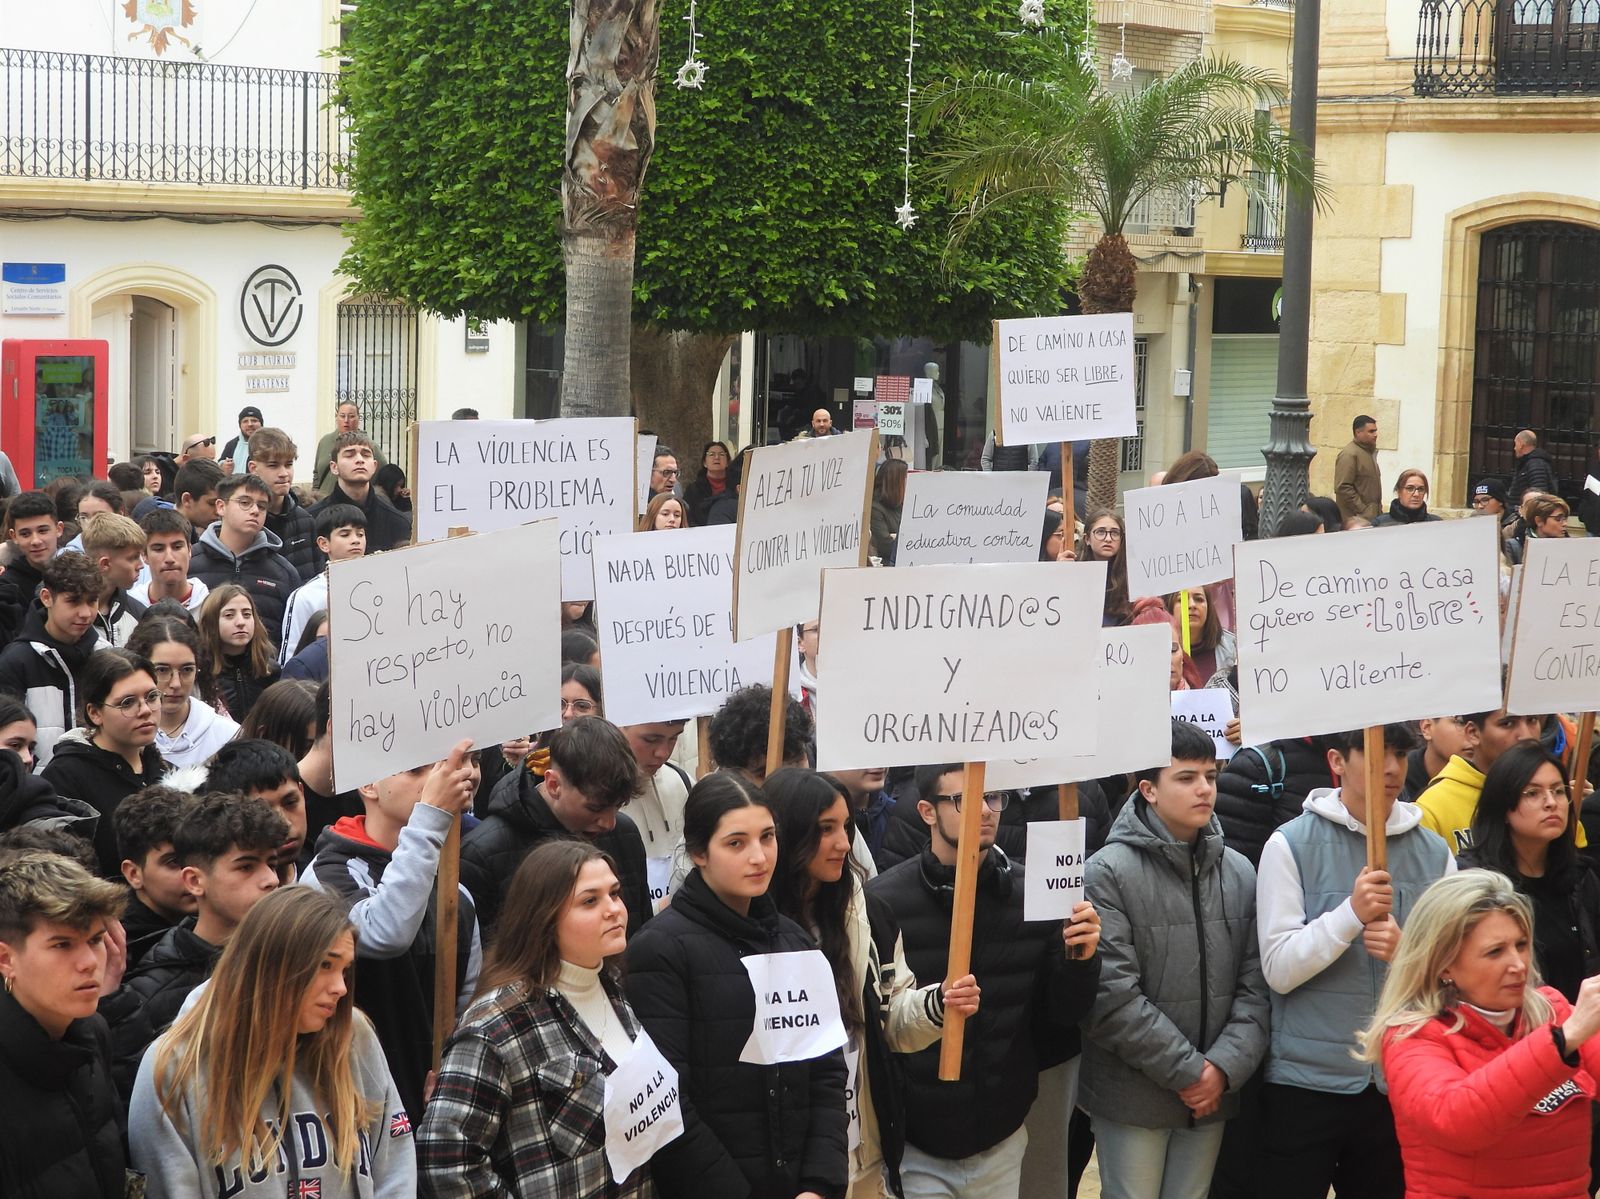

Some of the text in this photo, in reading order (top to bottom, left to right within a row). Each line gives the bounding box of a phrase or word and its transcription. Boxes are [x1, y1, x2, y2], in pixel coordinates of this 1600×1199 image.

[1008, 328, 1127, 352] DE CAMINO A CASA
[238, 354, 296, 366] CLUB TAURINO
[1008, 364, 1124, 384] QUIERO SER LIBRE,
[247, 378, 289, 389] VERATENSE
[880, 405, 902, 415] -30%
[1010, 400, 1103, 423] NO VALIENTE
[435, 434, 611, 466] LA VIOLENCIA ES
[434, 484, 467, 512] EL
[489, 477, 614, 510] PROBLEMA,
[753, 457, 844, 510] ALZA TU VOZ
[911, 494, 1027, 519] La comunidad
[1138, 493, 1220, 530] NO A LA
[747, 534, 790, 573] CONTRA
[795, 530, 808, 561] LA
[813, 513, 860, 556] VIOLENCIA
[905, 528, 1034, 550] educativa contra
[608, 558, 656, 583] NADA
[665, 553, 720, 580] BUENO
[1141, 541, 1222, 578] VIOLENCIA
[1541, 556, 1600, 587] LA E
[1258, 559, 1297, 603] De
[1305, 568, 1389, 595] camino
[1399, 571, 1414, 589] a
[343, 566, 466, 641] Si hay
[862, 594, 1062, 631] INDIGNAD@S
[1559, 602, 1588, 628] ES
[613, 606, 686, 644] DESPUÉS
[693, 613, 716, 637] DE
[1250, 607, 1315, 652] quiero
[1326, 603, 1364, 622] ser
[366, 623, 513, 689] respeto, no
[1105, 642, 1135, 666] RO,
[645, 660, 743, 699] VIOLENCIA
[943, 656, 962, 693] Y
[1254, 651, 1431, 694] no valiente.
[350, 671, 528, 752] hay violencia
[864, 701, 1059, 743] ORGANIZAD@S
[1190, 714, 1198, 723] A
[1201, 713, 1216, 722] LA
[1056, 854, 1073, 867] NO
[1046, 876, 1084, 890] VIOLEN
[771, 992, 782, 1004] A
[787, 990, 809, 1003] LA
[763, 1013, 821, 1031] VIENCIA
[629, 1070, 665, 1114] NO A LA
[624, 1086, 678, 1143] VIOLENCIA
